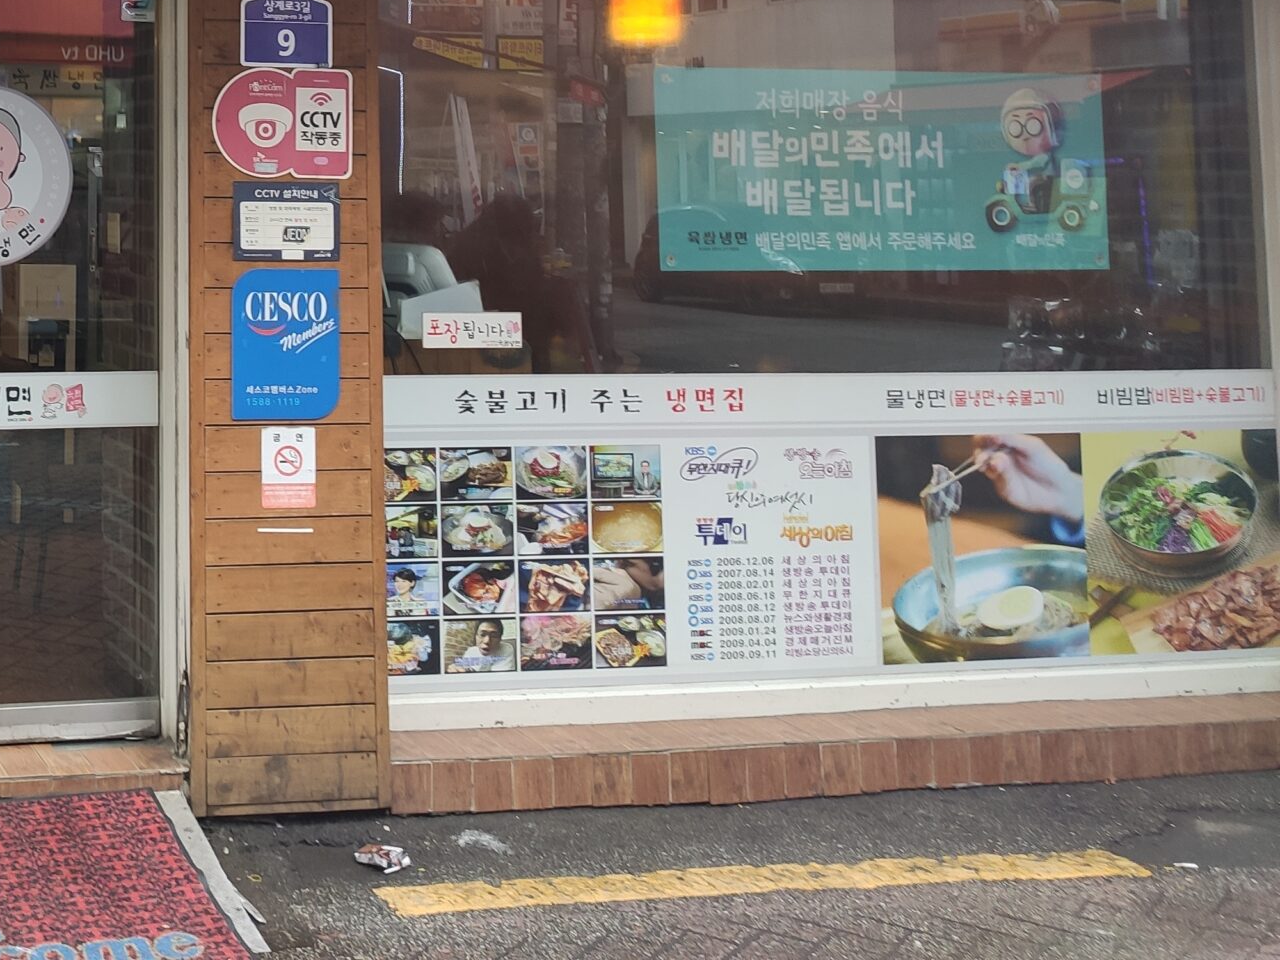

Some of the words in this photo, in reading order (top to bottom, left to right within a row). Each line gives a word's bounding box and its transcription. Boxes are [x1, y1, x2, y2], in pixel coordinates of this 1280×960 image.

[277, 29, 296, 57] 9
[755, 89, 850, 121] 저희매장
[858, 89, 904, 121] 음식
[300, 111, 341, 128] CCTV
[300, 131, 341, 146] 작동중
[712, 129, 944, 169] 배달의민족에서
[254, 189, 280, 198] CCTV
[283, 189, 319, 199] 설치안내
[746, 178, 916, 217] 배달됩니다
[755, 231, 832, 251] 배달의민족
[836, 231, 882, 251] 앱에서
[887, 232, 976, 251] 주문해주세요
[245, 291, 328, 321] CESCO
[280, 318, 335, 351] Members
[427, 319, 504, 344] 포장됩니다
[455, 389, 567, 414] 숯불고기
[590, 389, 643, 413] 주는
[666, 387, 745, 413] 냉면집
[886, 389, 947, 409] 물냉면
[685, 446, 705, 456] KBS
[799, 459, 853, 479] 오늘아침
[716, 557, 774, 567] 2006.12.06
[717, 569, 775, 578] 2007.08.14
[717, 580, 775, 590] 2008.02.01
[718, 591, 775, 602] 2008.06.18
[718, 603, 776, 613] 2008.08.12
[718, 615, 776, 625] 2008.08.07
[719, 626, 777, 637] 2009.01.24
[719, 638, 777, 649] 2009.04.04
[719, 650, 777, 660] 2009.09.11
